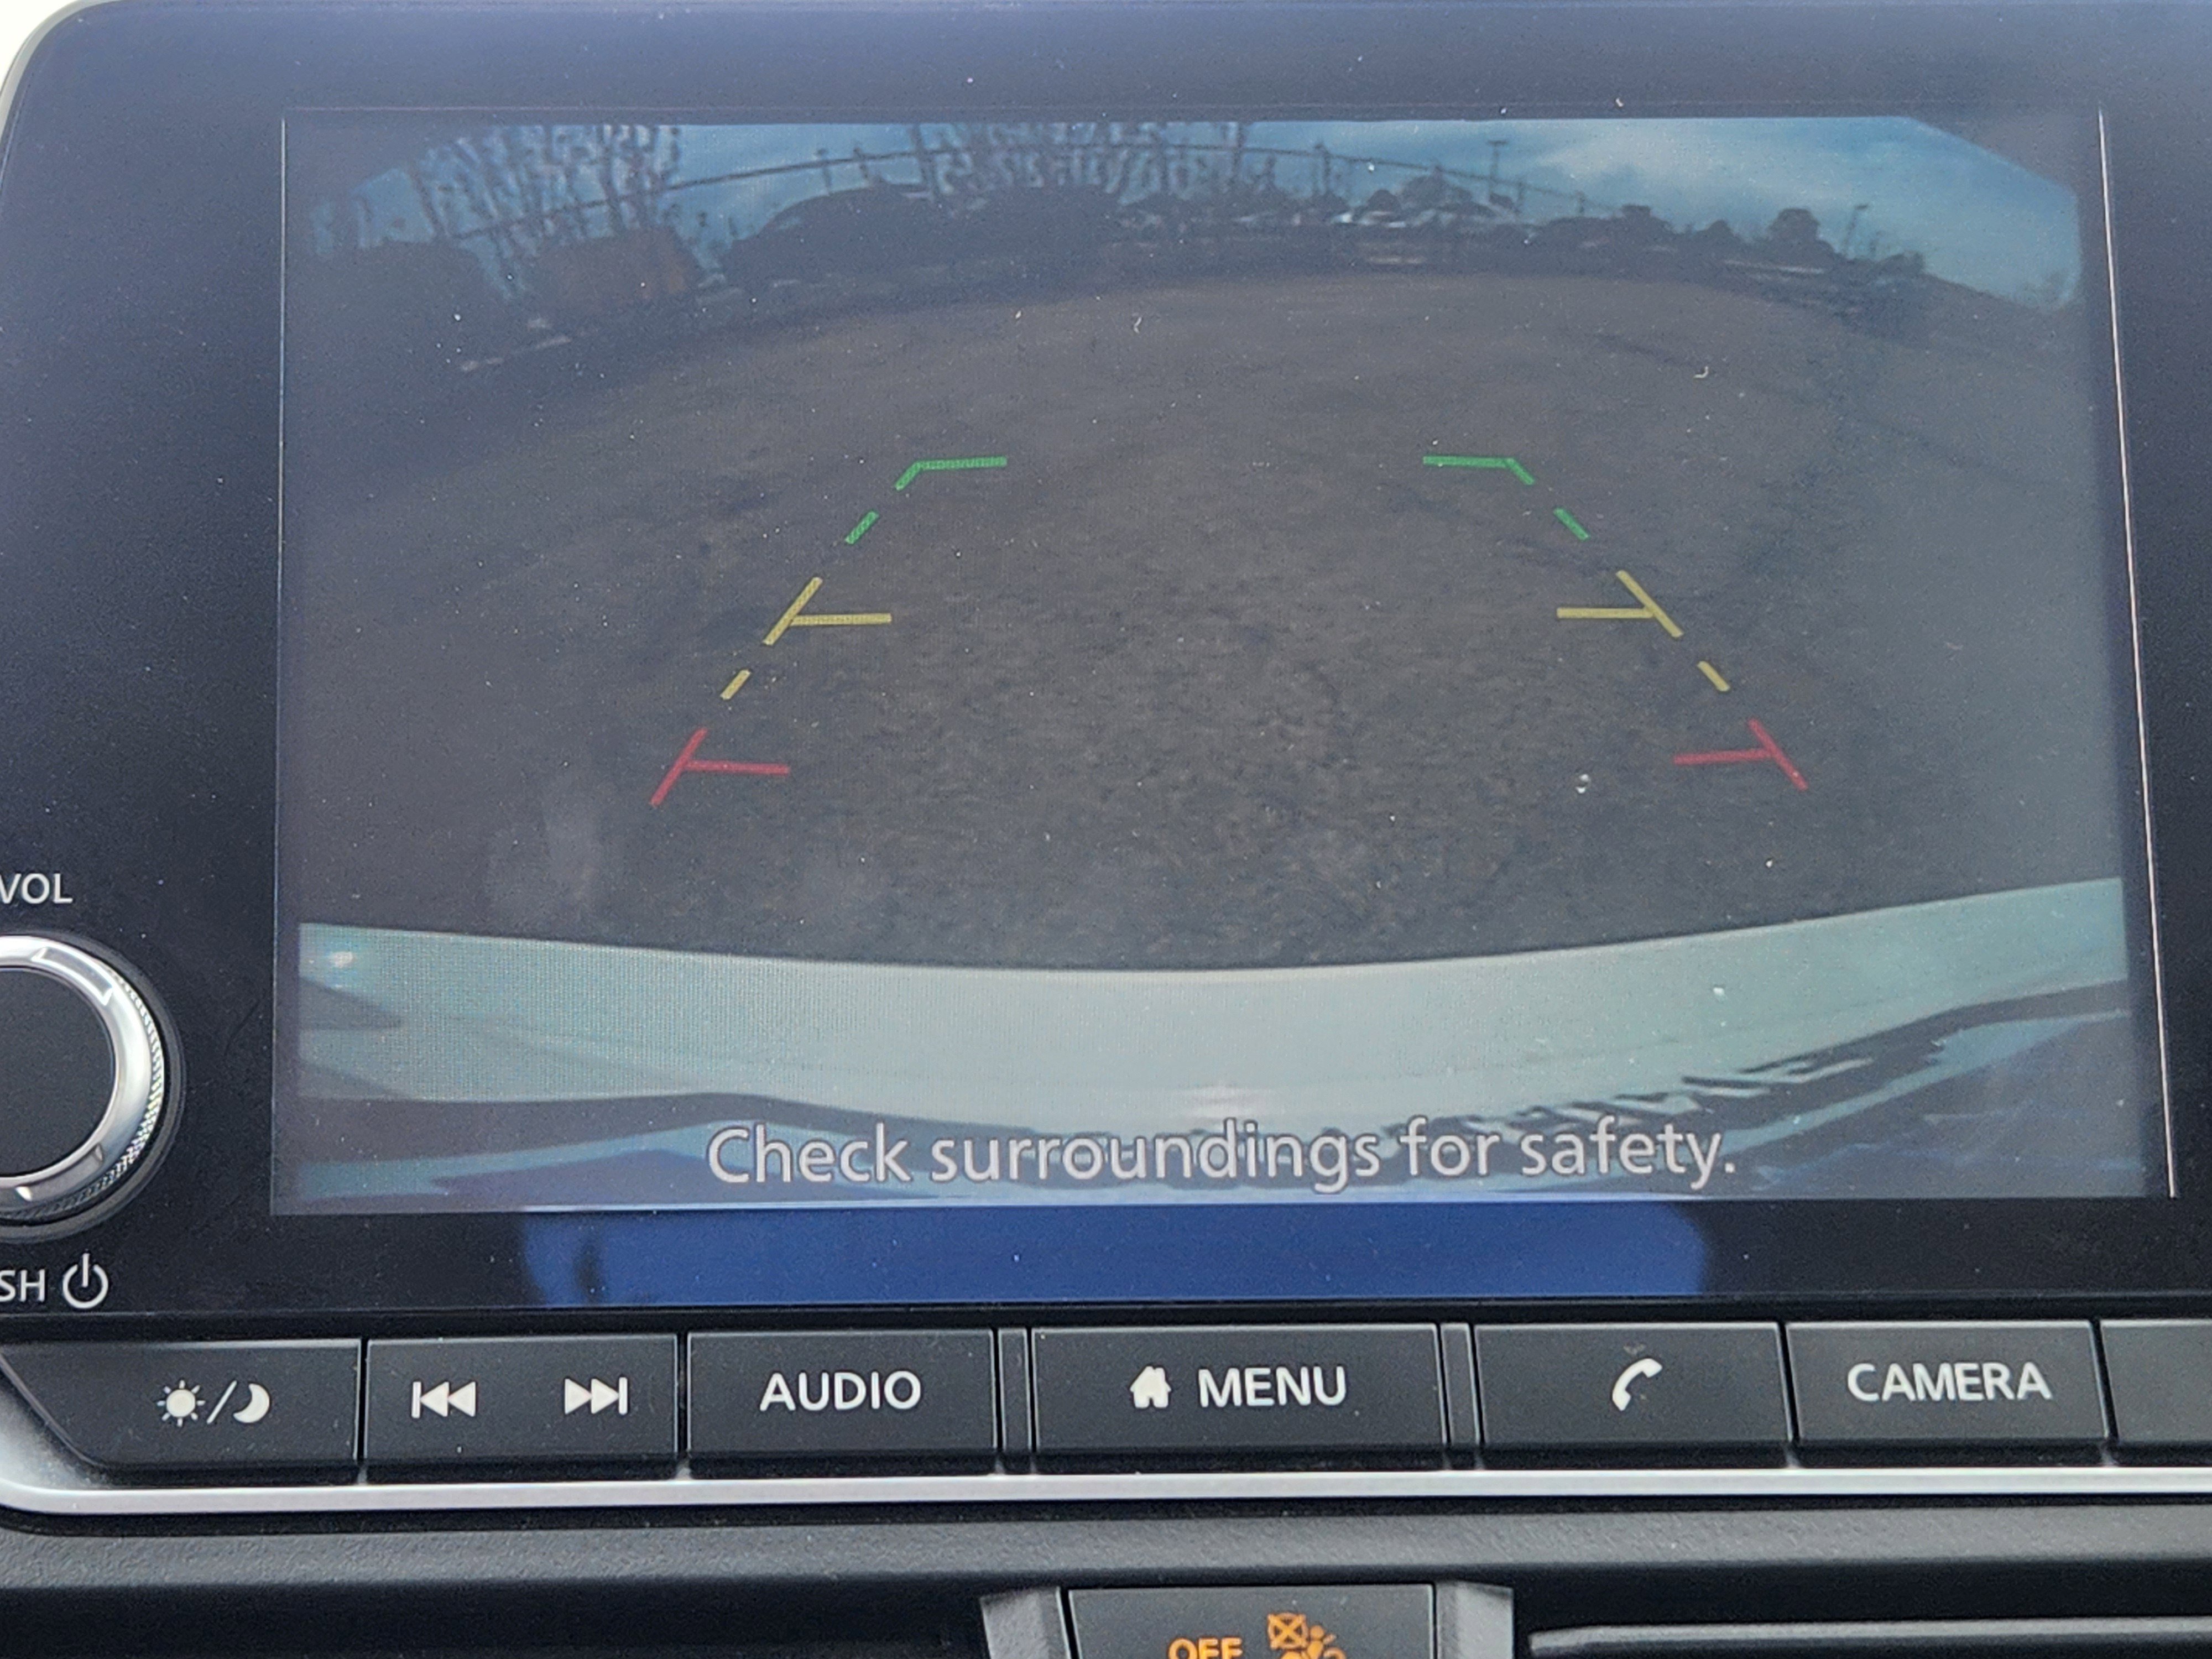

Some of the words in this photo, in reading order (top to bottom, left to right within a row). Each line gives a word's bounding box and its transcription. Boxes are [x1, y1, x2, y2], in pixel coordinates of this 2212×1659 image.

[0, 873, 74, 904] VOL
[708, 1123, 911, 1183] Check
[931, 1118, 1381, 1193] surroundings
[1400, 1116, 1500, 1176] for
[1521, 1115, 1735, 1190] safety.
[760, 1370, 922, 1412] AUDIO
[1198, 1366, 1348, 1407] MENU
[1847, 1362, 2052, 1402] CAMERA
[1168, 1637, 1243, 1659] OFF
